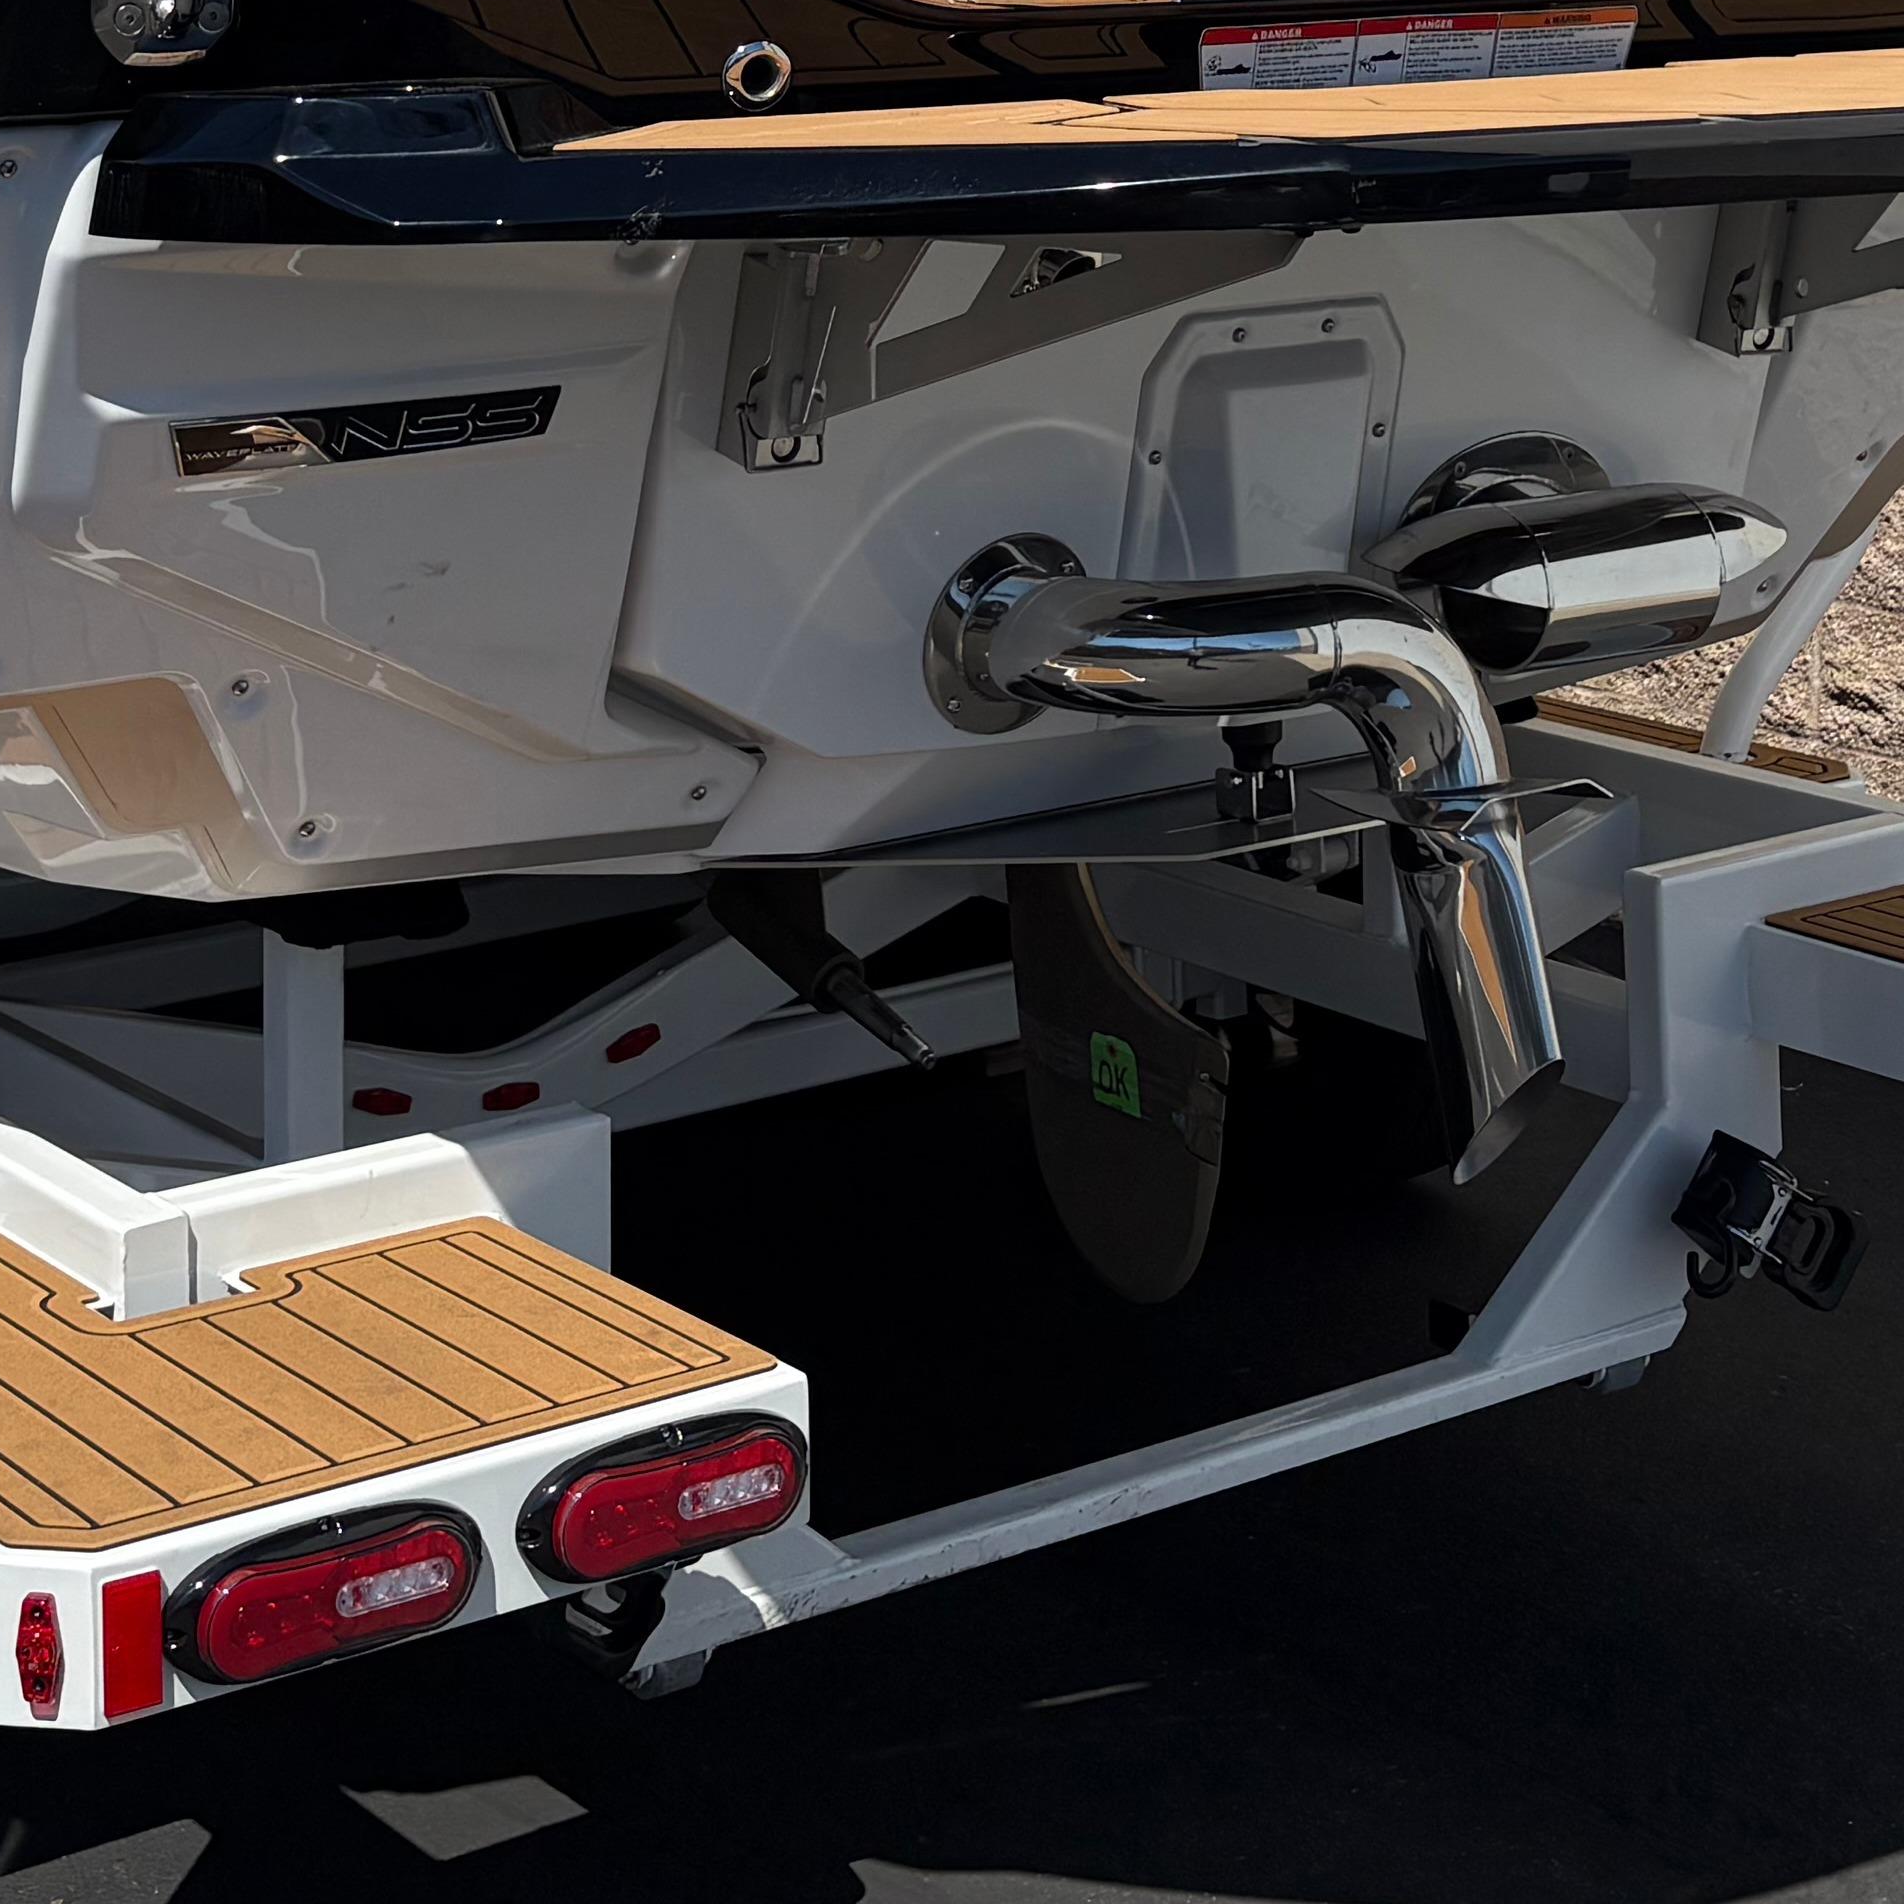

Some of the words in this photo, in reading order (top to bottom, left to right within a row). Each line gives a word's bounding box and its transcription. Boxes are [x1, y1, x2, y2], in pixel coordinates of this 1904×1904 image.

[1414, 19, 1454, 29] DANGER
[1260, 28, 1302, 39] DANGER
[332, 396, 542, 455] NSS
